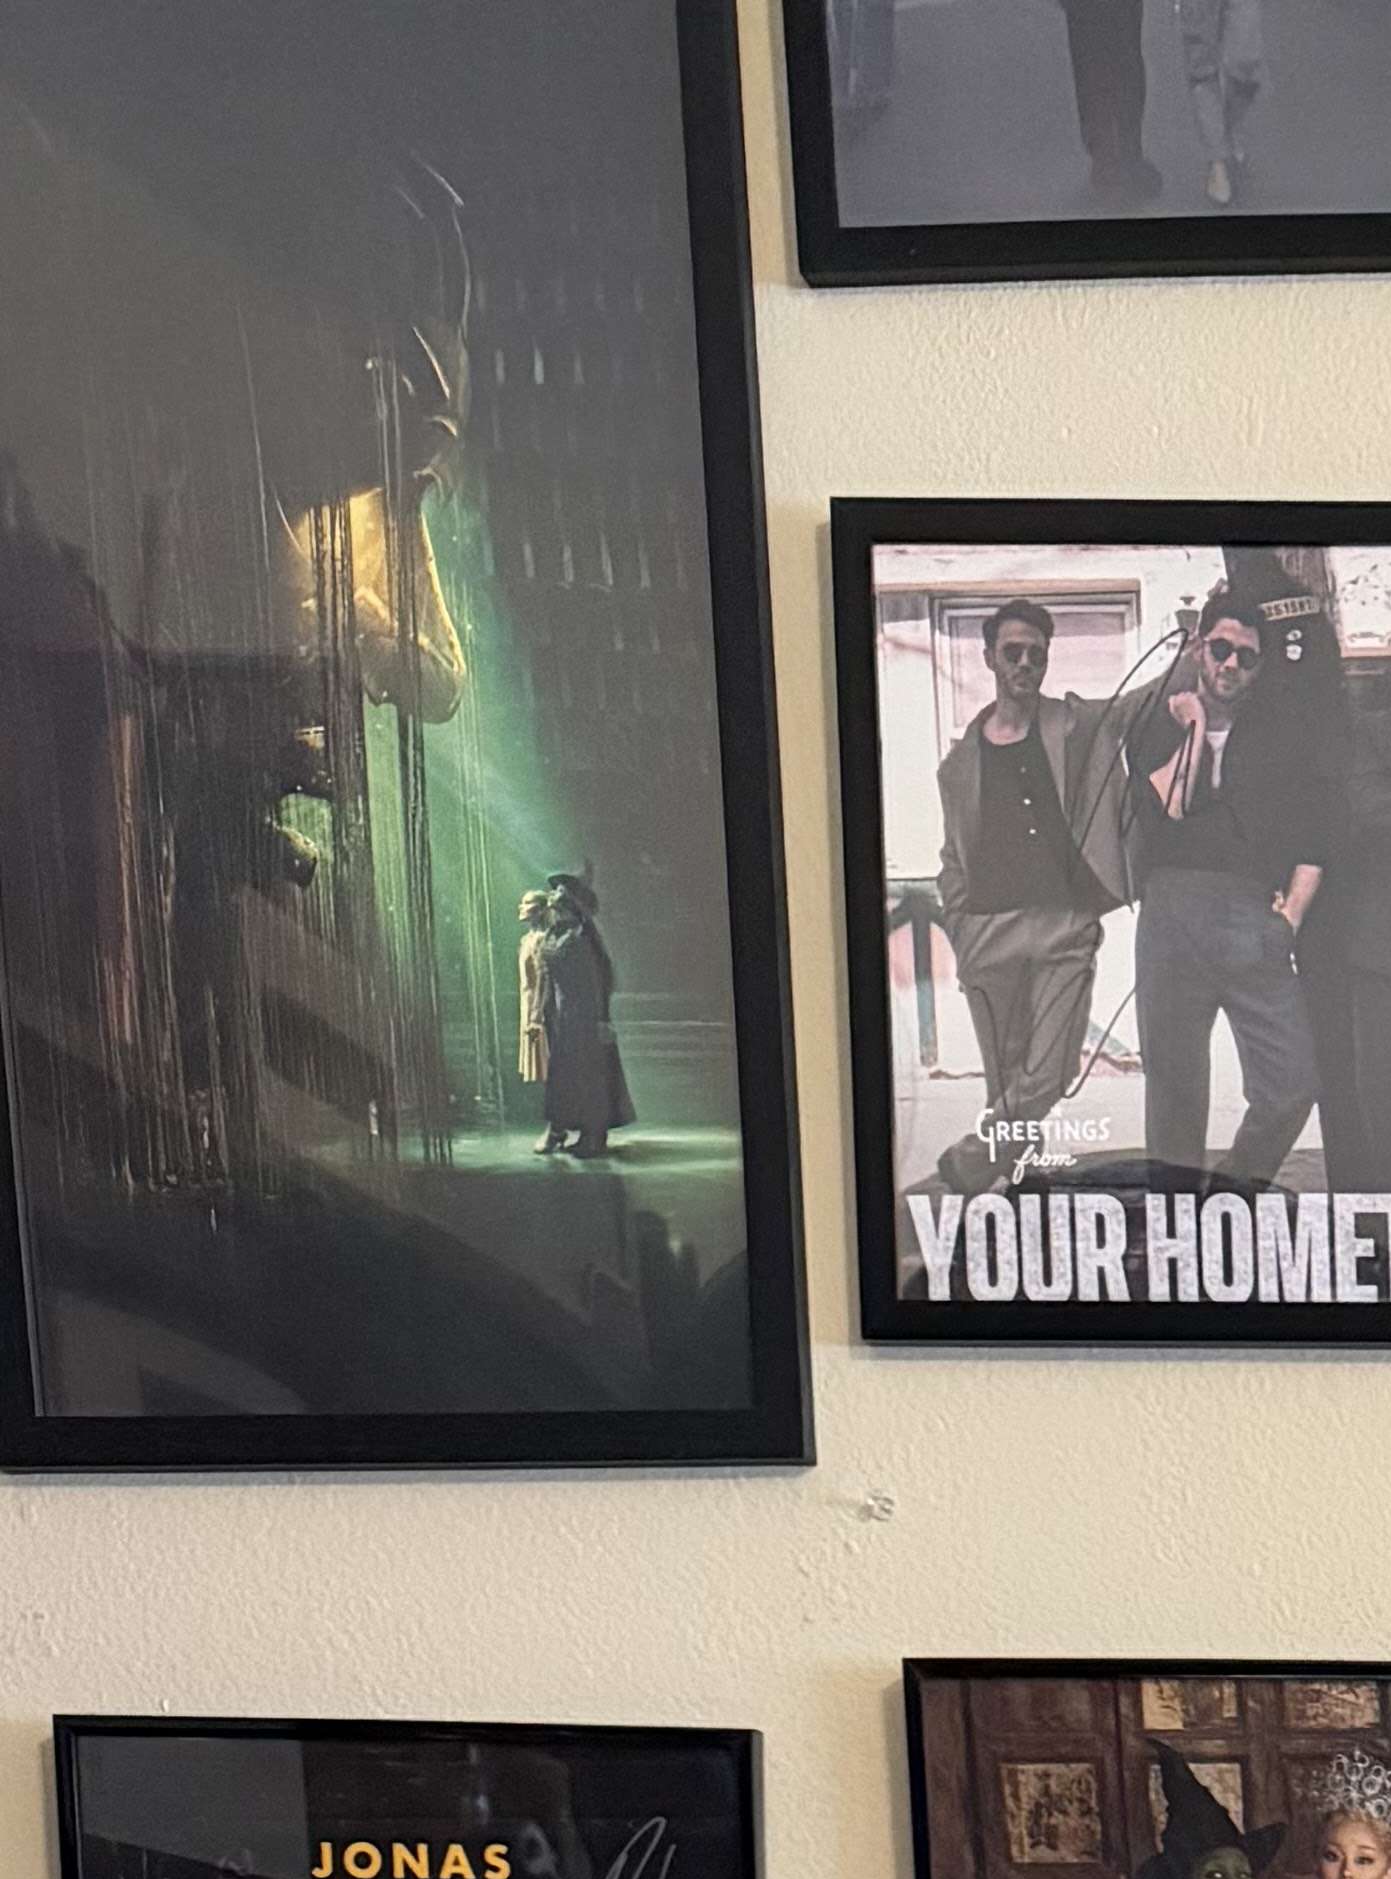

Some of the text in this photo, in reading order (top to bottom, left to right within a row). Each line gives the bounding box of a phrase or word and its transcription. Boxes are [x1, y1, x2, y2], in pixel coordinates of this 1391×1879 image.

[975, 1108, 1111, 1163] GREETINGS
[1011, 1144, 1078, 1185] from
[905, 1193, 1131, 1303] YOUR
